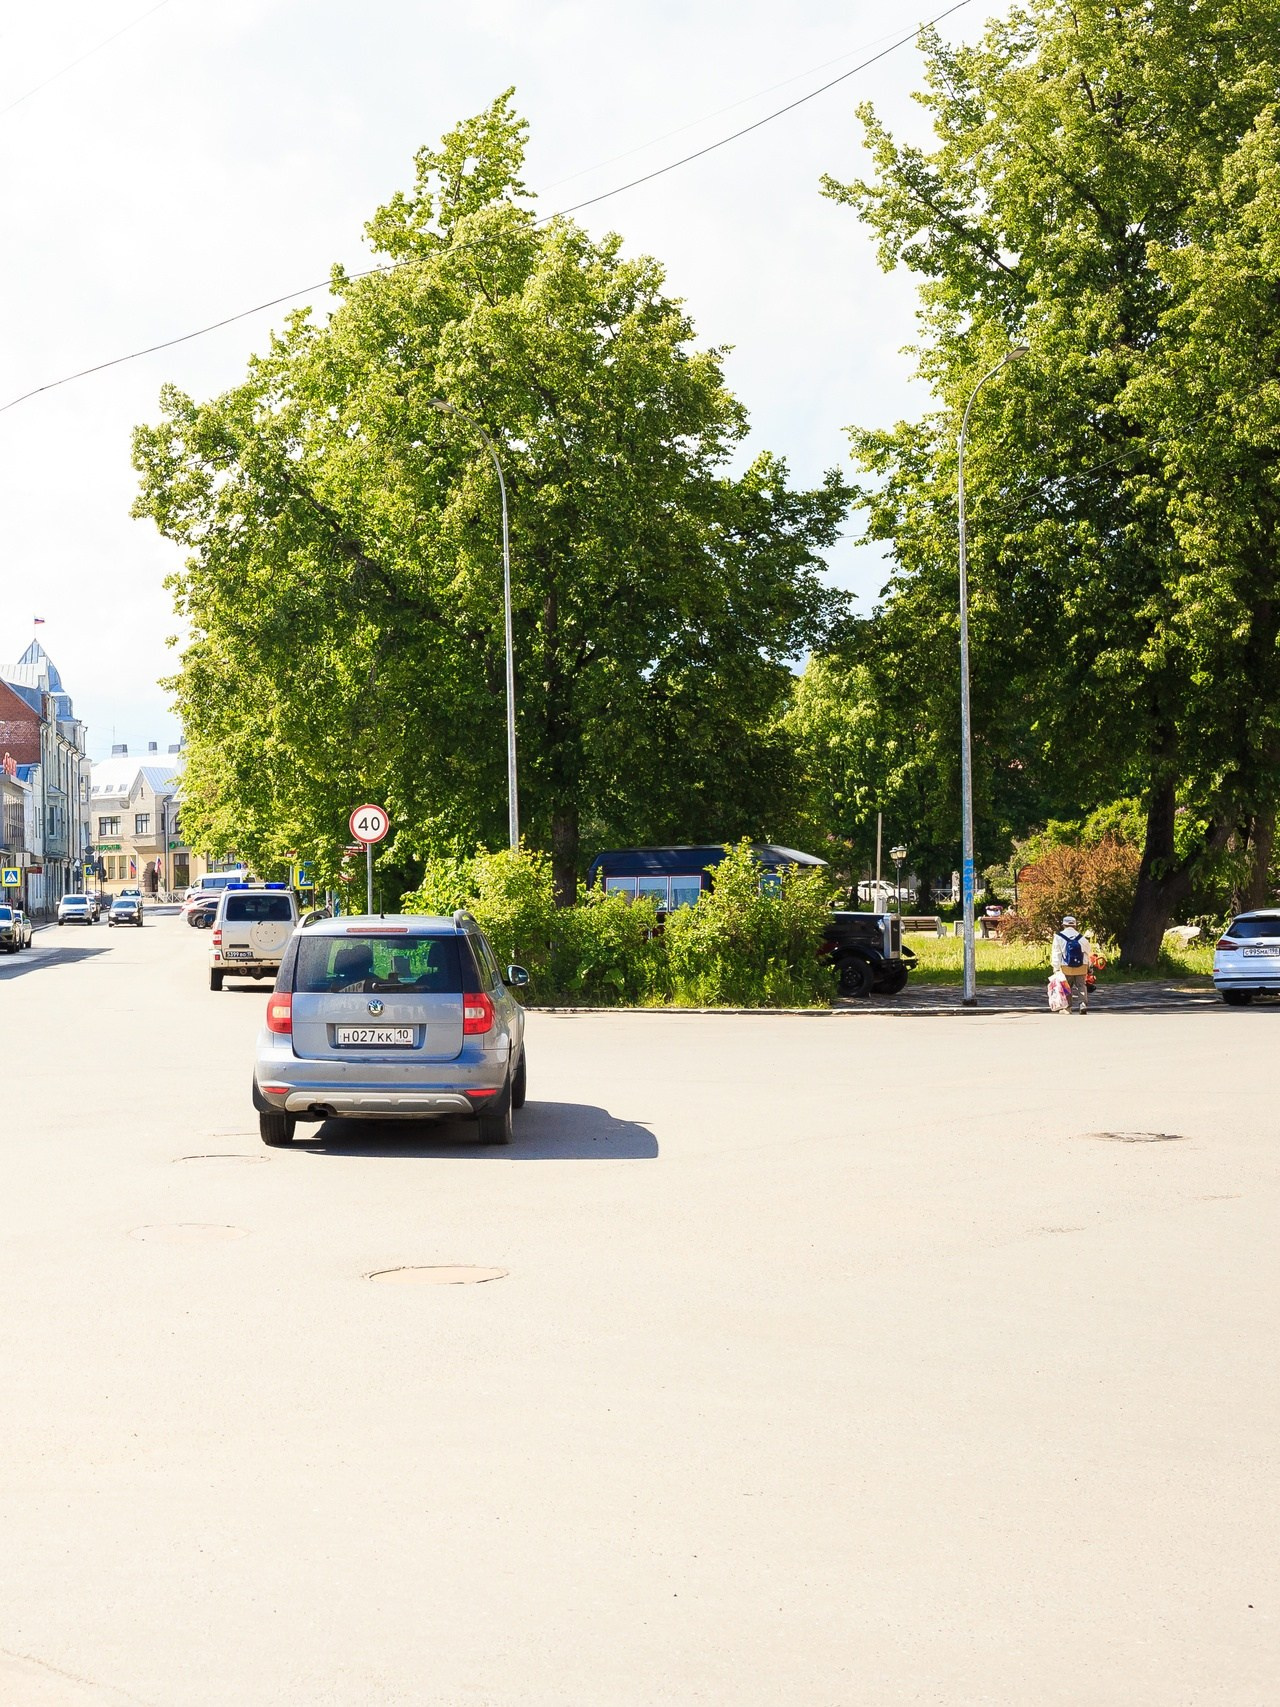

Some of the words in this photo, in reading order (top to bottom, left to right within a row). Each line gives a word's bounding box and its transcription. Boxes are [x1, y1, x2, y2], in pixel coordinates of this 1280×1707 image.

[358, 816, 380, 831] 40
[343, 1030, 393, 1042] Н027КК
[397, 1030, 409, 1039] 10
